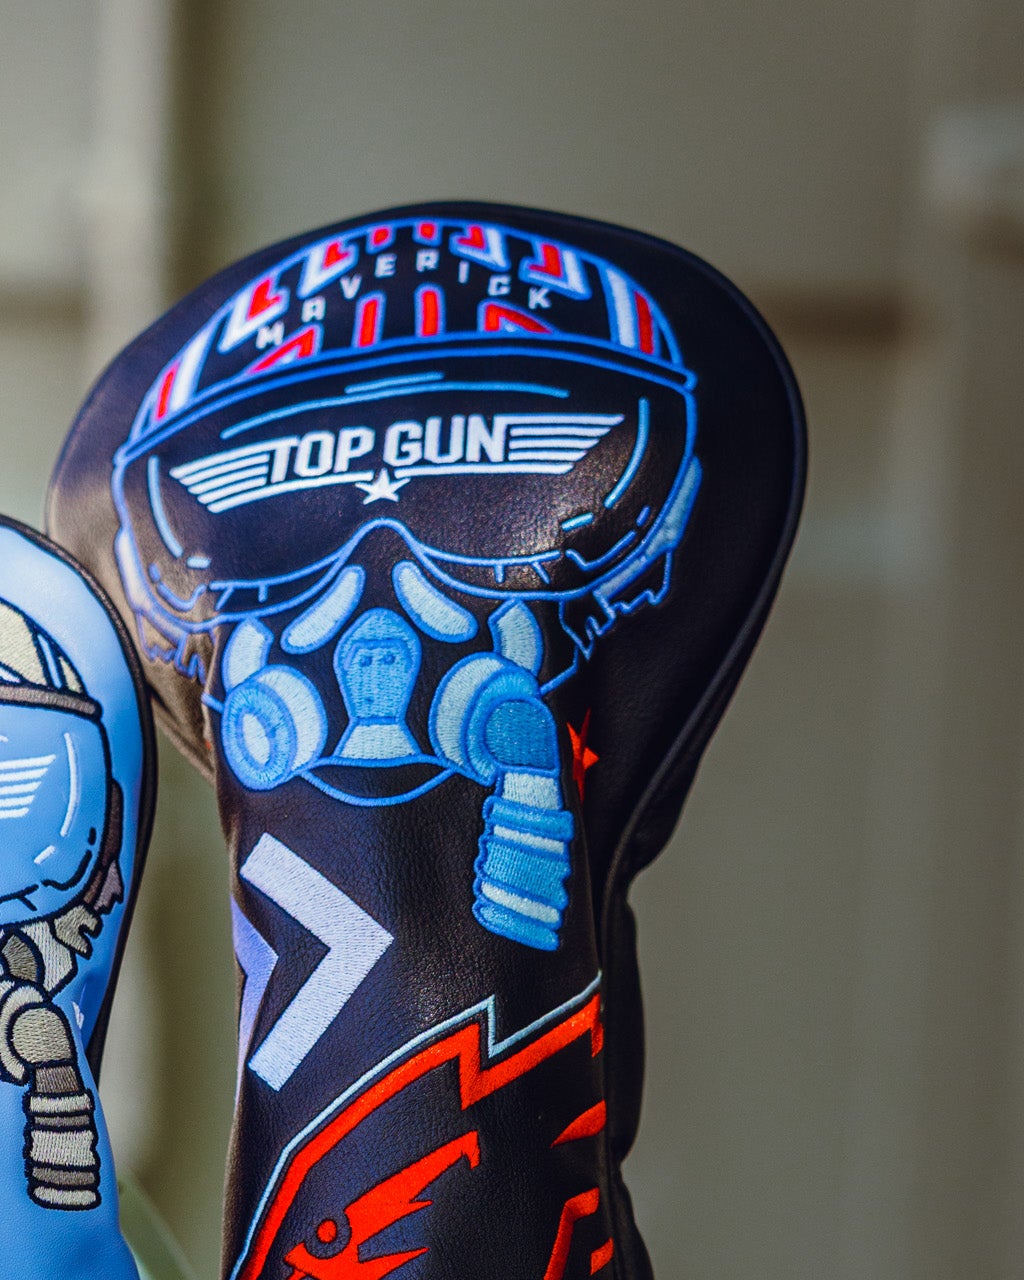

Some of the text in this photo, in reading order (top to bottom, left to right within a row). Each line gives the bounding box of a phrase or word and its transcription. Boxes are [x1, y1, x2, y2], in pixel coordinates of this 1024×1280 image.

[256, 250, 552, 349] MAVERICK
[266, 414, 504, 483] TOP GUN
